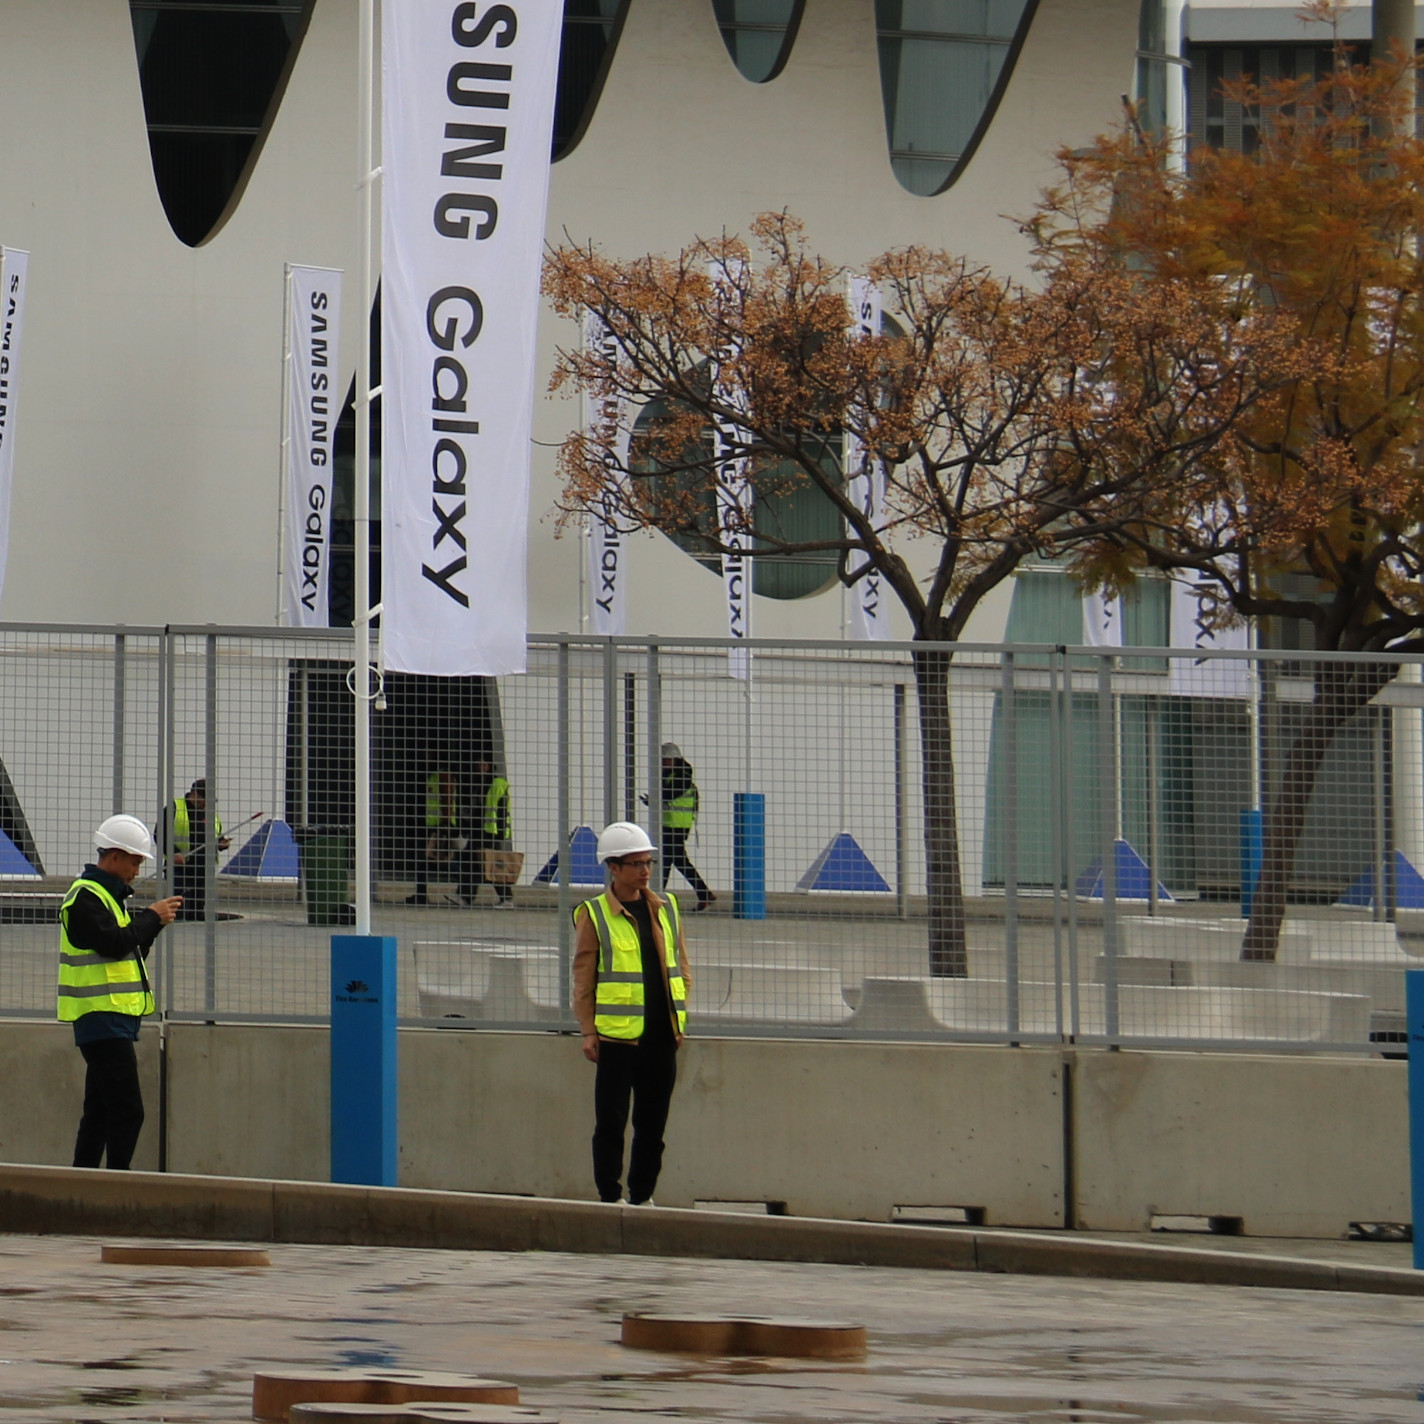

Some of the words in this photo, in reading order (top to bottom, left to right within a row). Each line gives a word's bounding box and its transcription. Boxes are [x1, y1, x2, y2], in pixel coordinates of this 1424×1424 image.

[309, 290, 329, 467] SAMSUNG
[421, 284, 485, 610] Galaxy
[301, 483, 327, 613] Galaxy
